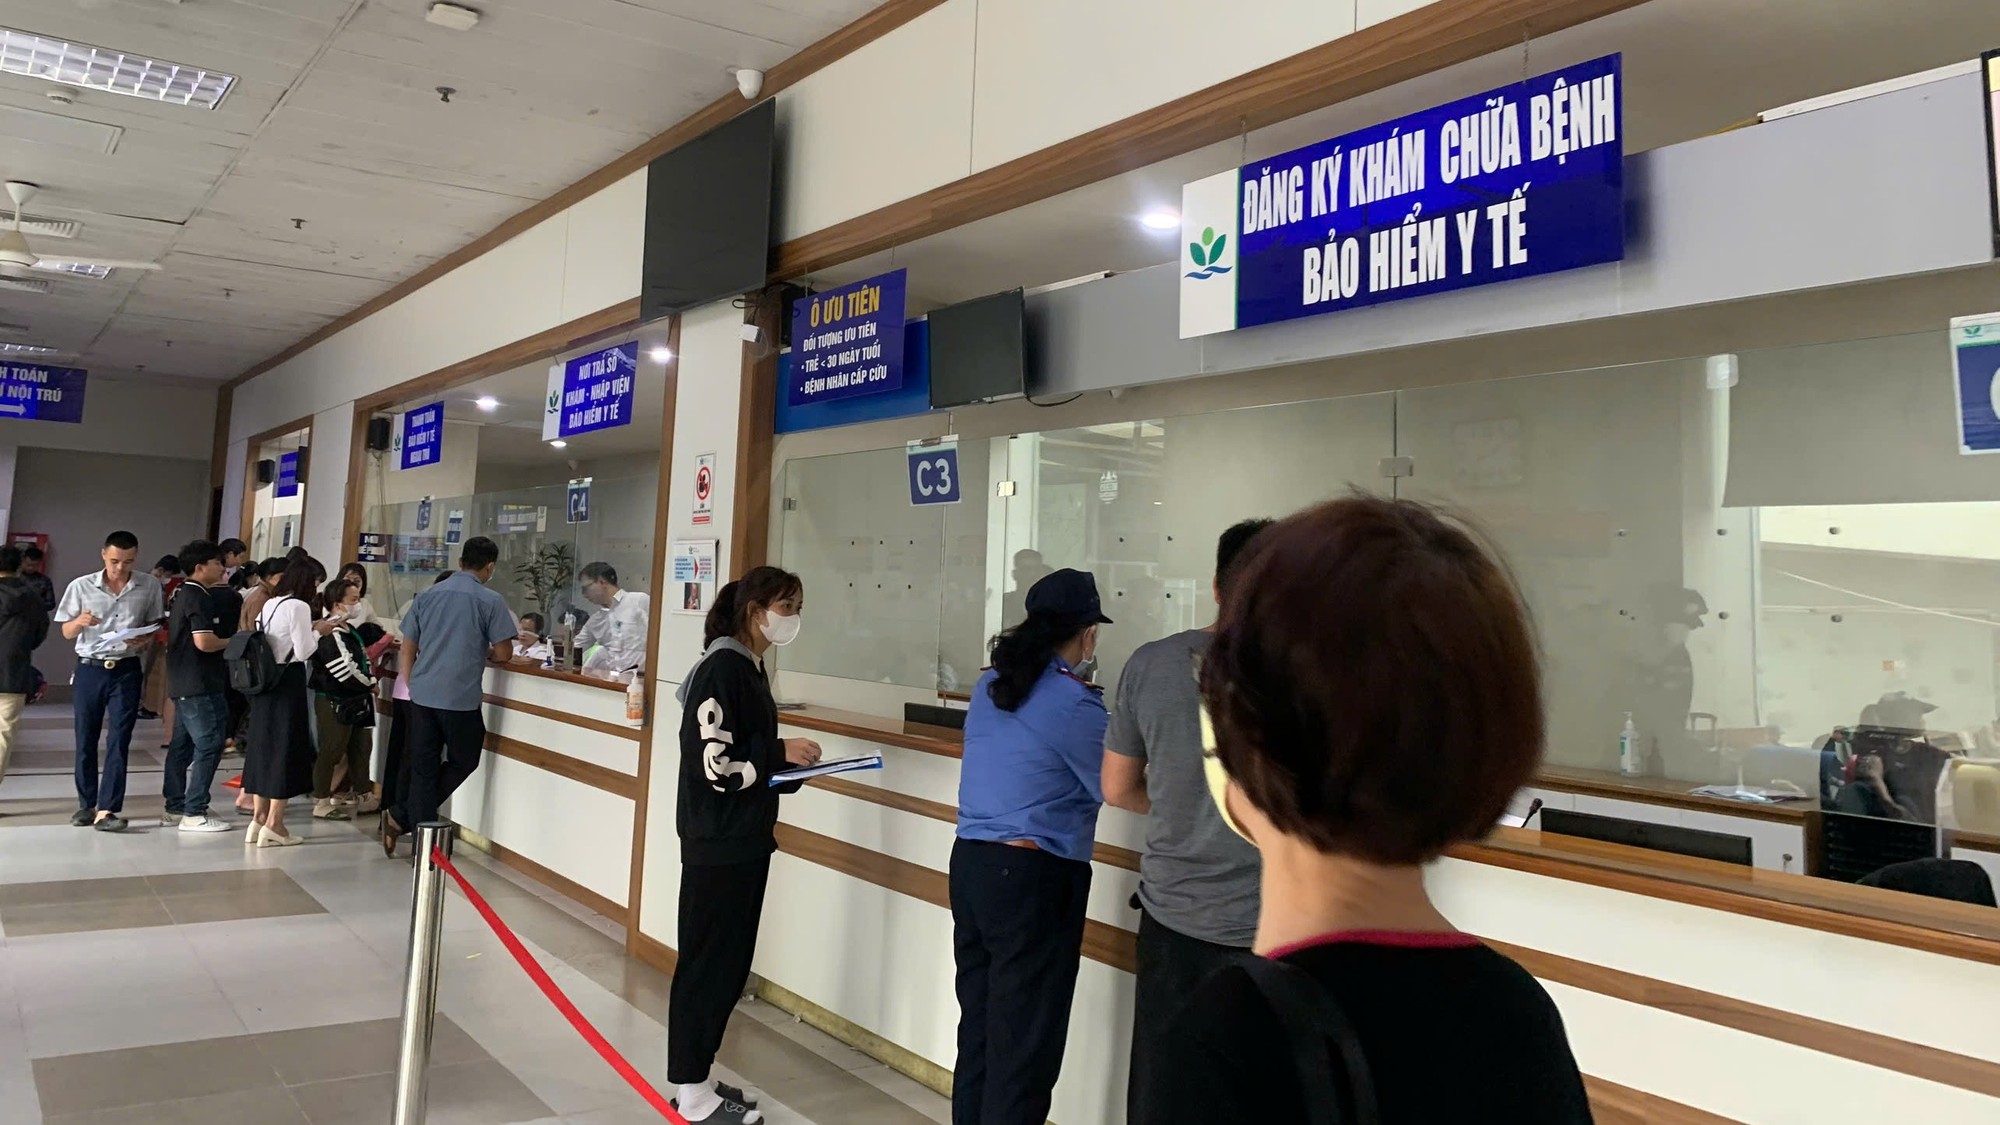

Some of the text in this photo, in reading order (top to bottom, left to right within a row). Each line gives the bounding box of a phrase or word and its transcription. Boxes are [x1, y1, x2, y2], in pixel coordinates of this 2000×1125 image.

[1243, 73, 1615, 235] ĐĂNG KÝ KHÁM CHỮA BỆNH
[1303, 181, 1531, 305] BẢO HIỂM Y TẾ
[810, 284, 880, 327] Ô ƯU TIÊN
[803, 320, 876, 352] ĐỐI TƯỢNG ƯU TIÊN
[805, 354, 819, 372] TRẺ
[827, 354, 837, 368] 30
[838, 347, 861, 366] NGÀY
[862, 338, 881, 361] TUỔI
[11, 367, 48, 383] TOÁN
[804, 363, 888, 395] BỆNH NHÂN CẤP CỨU
[7, 384, 33, 401] NỘI
[36, 388, 62, 402] TRÚ
[603, 405, 609, 421] Y
[917, 458, 951, 496] C3
[570, 492, 587, 518] C4
